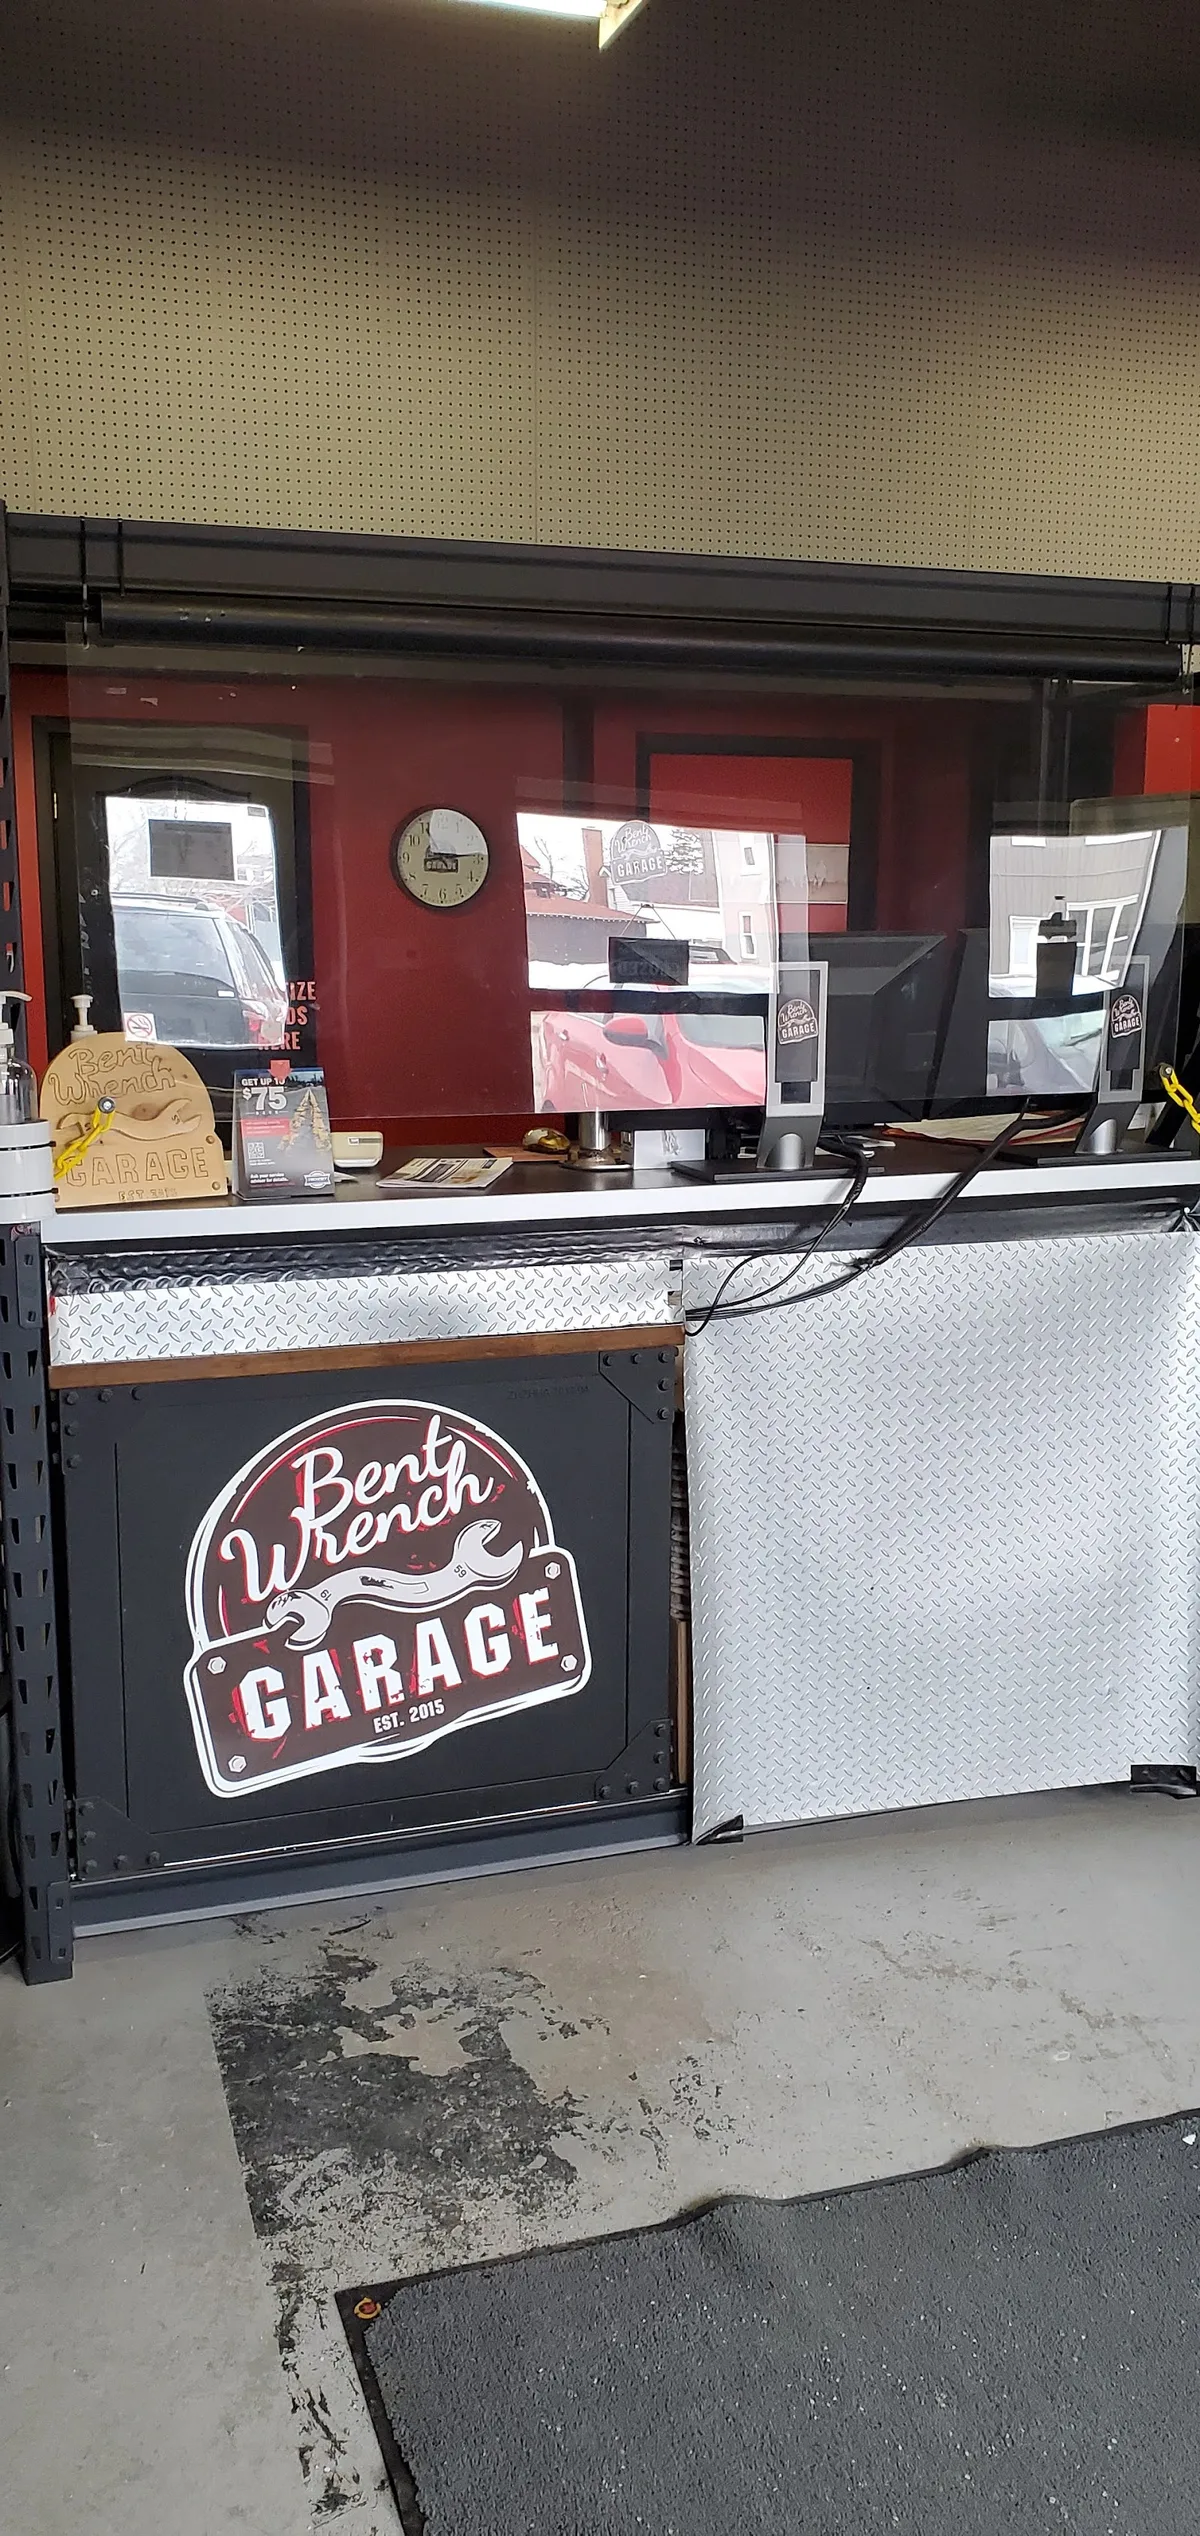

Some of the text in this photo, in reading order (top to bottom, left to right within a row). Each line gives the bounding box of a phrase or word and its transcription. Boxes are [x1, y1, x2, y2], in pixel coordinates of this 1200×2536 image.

[624, 824, 648, 840] Bent
[408, 834, 421, 847] 10
[614, 830, 652, 854] Wrench
[402, 851, 410, 864] 9
[472, 853, 481, 866] 3
[617, 856, 663, 877] GARAGE
[408, 871, 417, 881] 8
[466, 870, 475, 883] 4
[421, 883, 429, 896] 7
[438, 888, 447, 900] 6
[455, 882, 463, 895] 5
[781, 1022, 815, 1038] GARAGE
[1114, 1016, 1140, 1032] GARAGE
[68, 1043, 157, 1076] Bent
[241, 1078, 258, 1087] GET
[260, 1078, 271, 1086] UP
[242, 1086, 287, 1111] $75
[65, 1147, 209, 1188] GARAGE
[293, 1414, 453, 1525] Bent
[220, 1439, 495, 1602] Wrench
[453, 1564, 467, 1579] 59
[235, 1586, 560, 1741] GARAGE
[373, 1698, 446, 1734] EST. 2015
